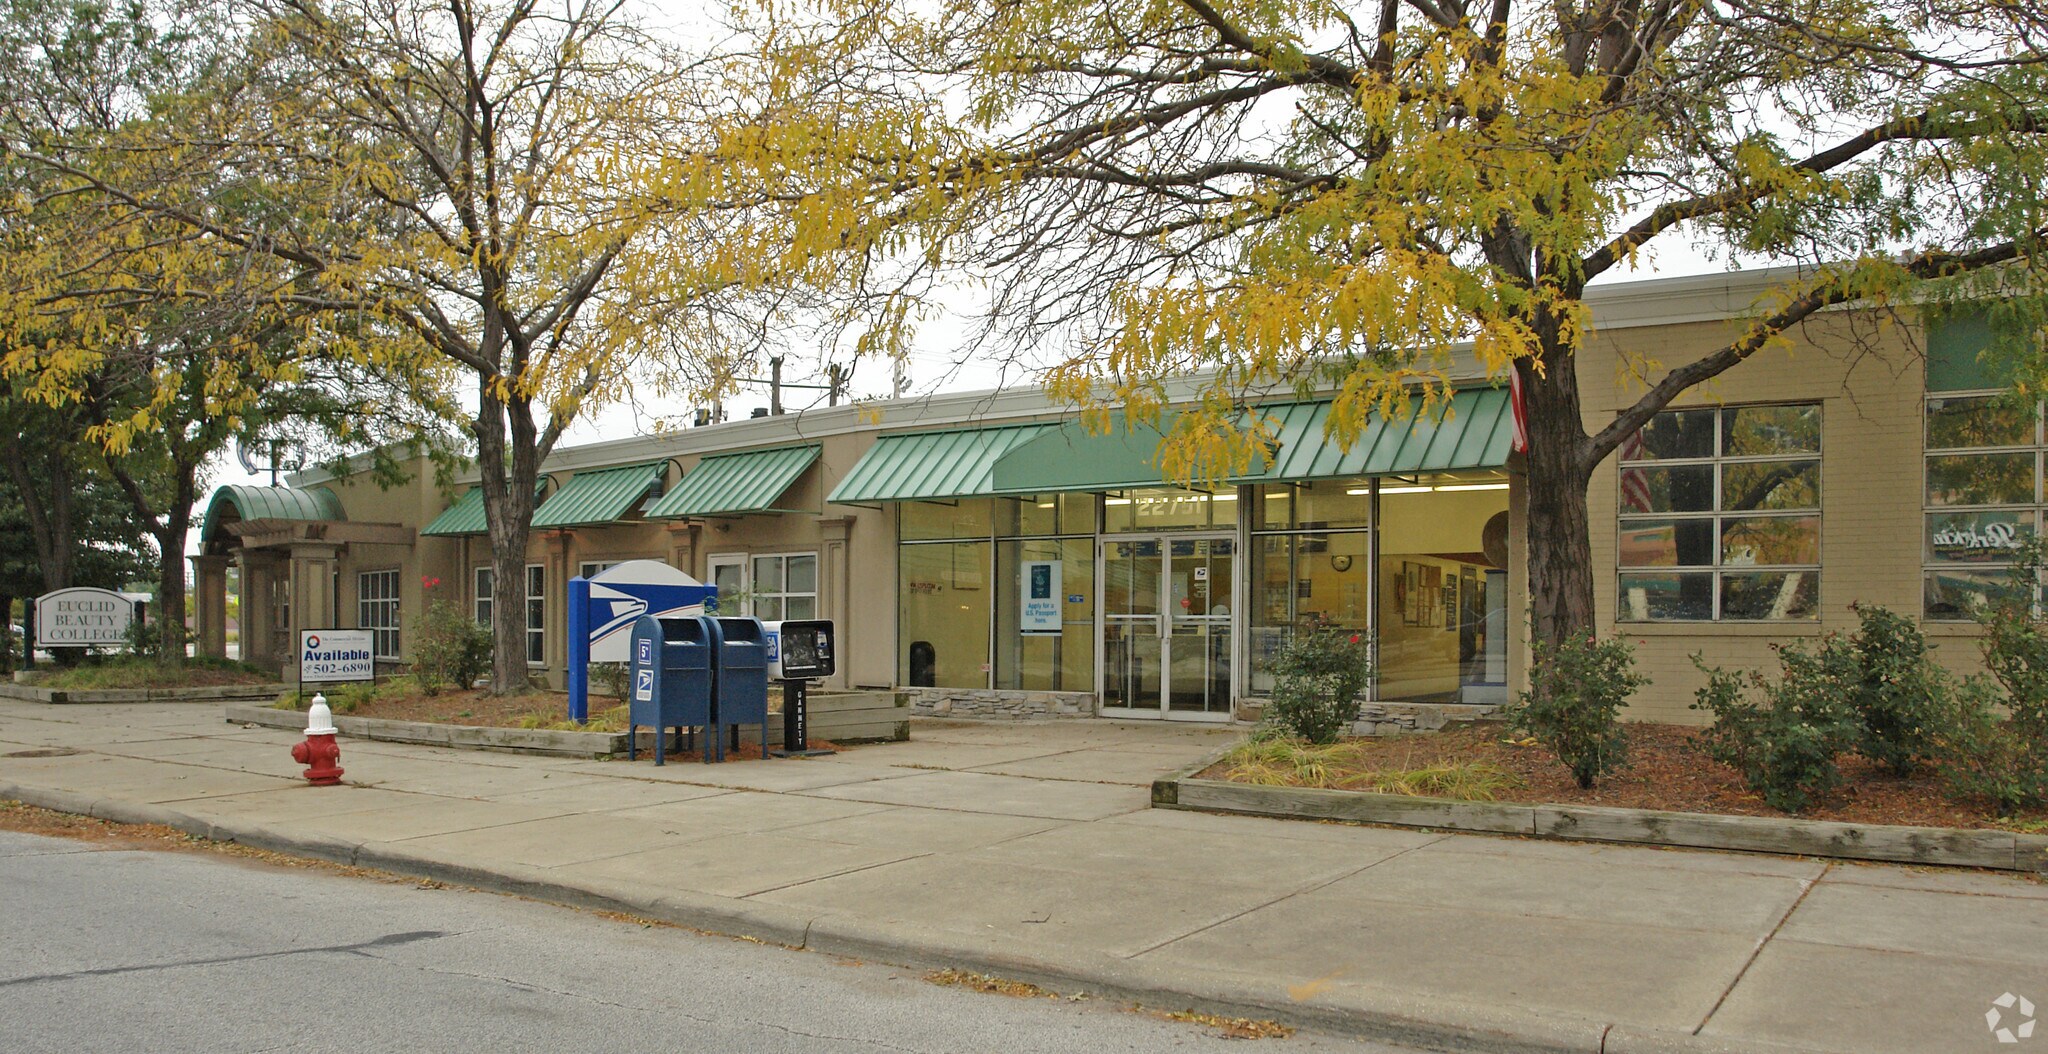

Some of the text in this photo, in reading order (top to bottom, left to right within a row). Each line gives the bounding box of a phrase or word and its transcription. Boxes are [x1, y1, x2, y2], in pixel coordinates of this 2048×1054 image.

[58, 600, 116, 612] EUCLID
[56, 614, 117, 626] BEAUTY
[304, 650, 370, 661] Available
[314, 662, 370, 674] 502-6890
